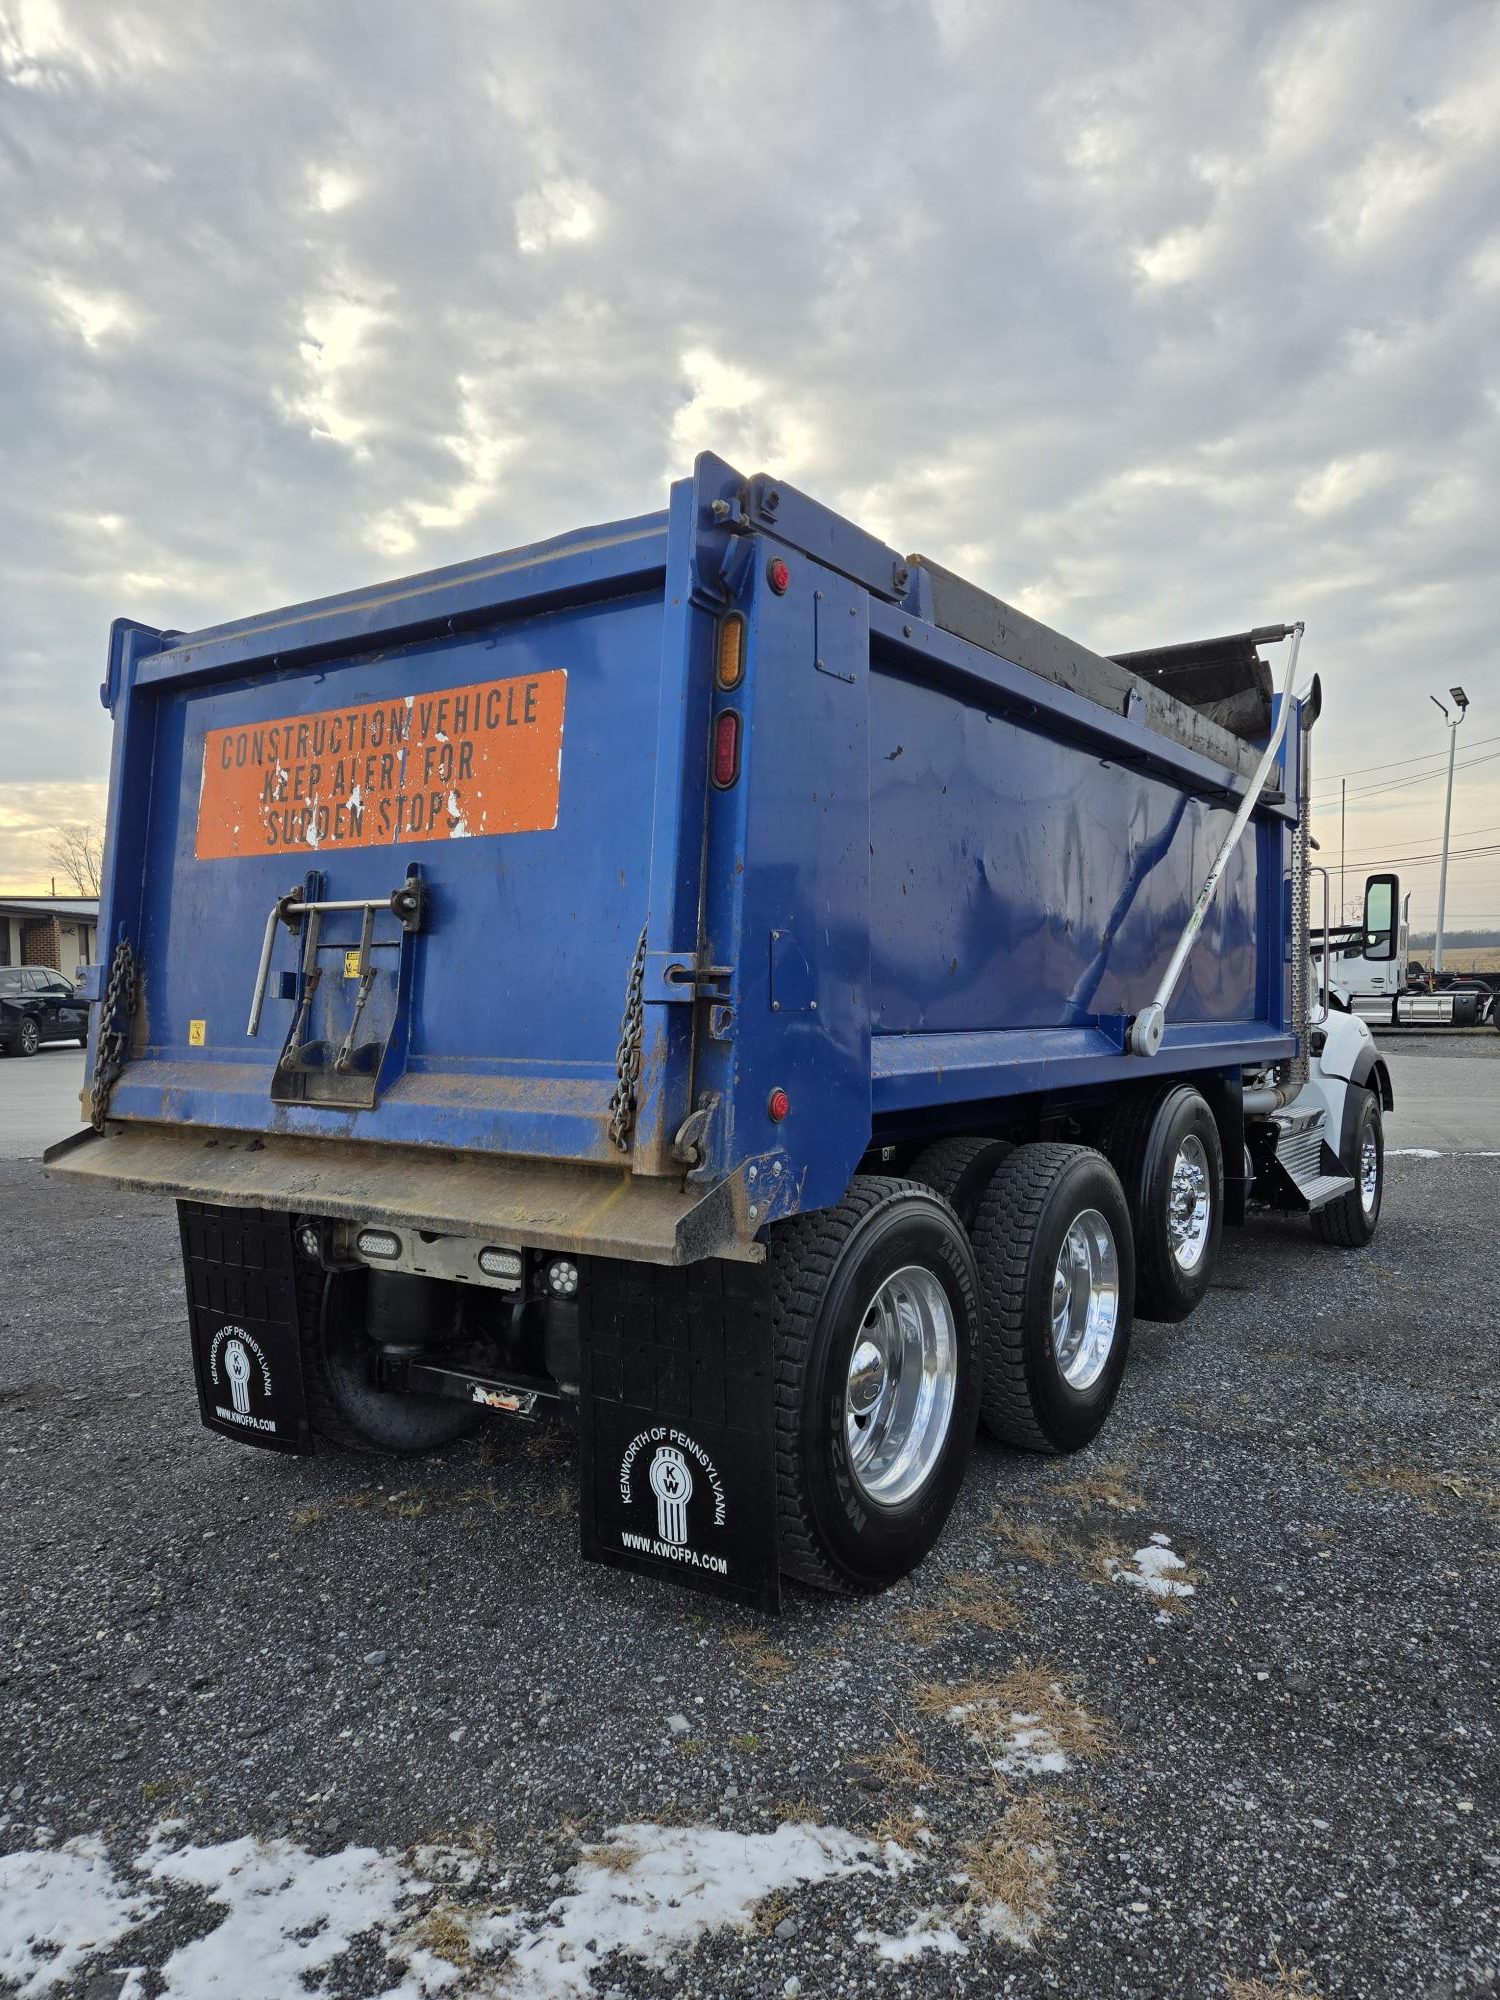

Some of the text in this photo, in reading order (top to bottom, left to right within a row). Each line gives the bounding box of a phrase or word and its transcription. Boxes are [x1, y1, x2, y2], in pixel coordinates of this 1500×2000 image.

[221, 682, 538, 769] CONSTRUCTION VEHICLE
[264, 741, 474, 804] KEEP ALERT FOR
[266, 789, 461, 846] SUDDEN STOPS
[210, 1325, 272, 1396] KENWORTH OF PENNSYLVANIA
[233, 1354, 240, 1364] K
[233, 1365, 242, 1376] W
[215, 1405, 277, 1433] WWW.KWOFPA.COM
[619, 1427, 726, 1526] KENWORTH OF PENNSYLVANIA
[663, 1479, 679, 1495] W
[665, 1465, 676, 1480] K
[621, 1532, 728, 1575] WWW.KWOFPA.COM
